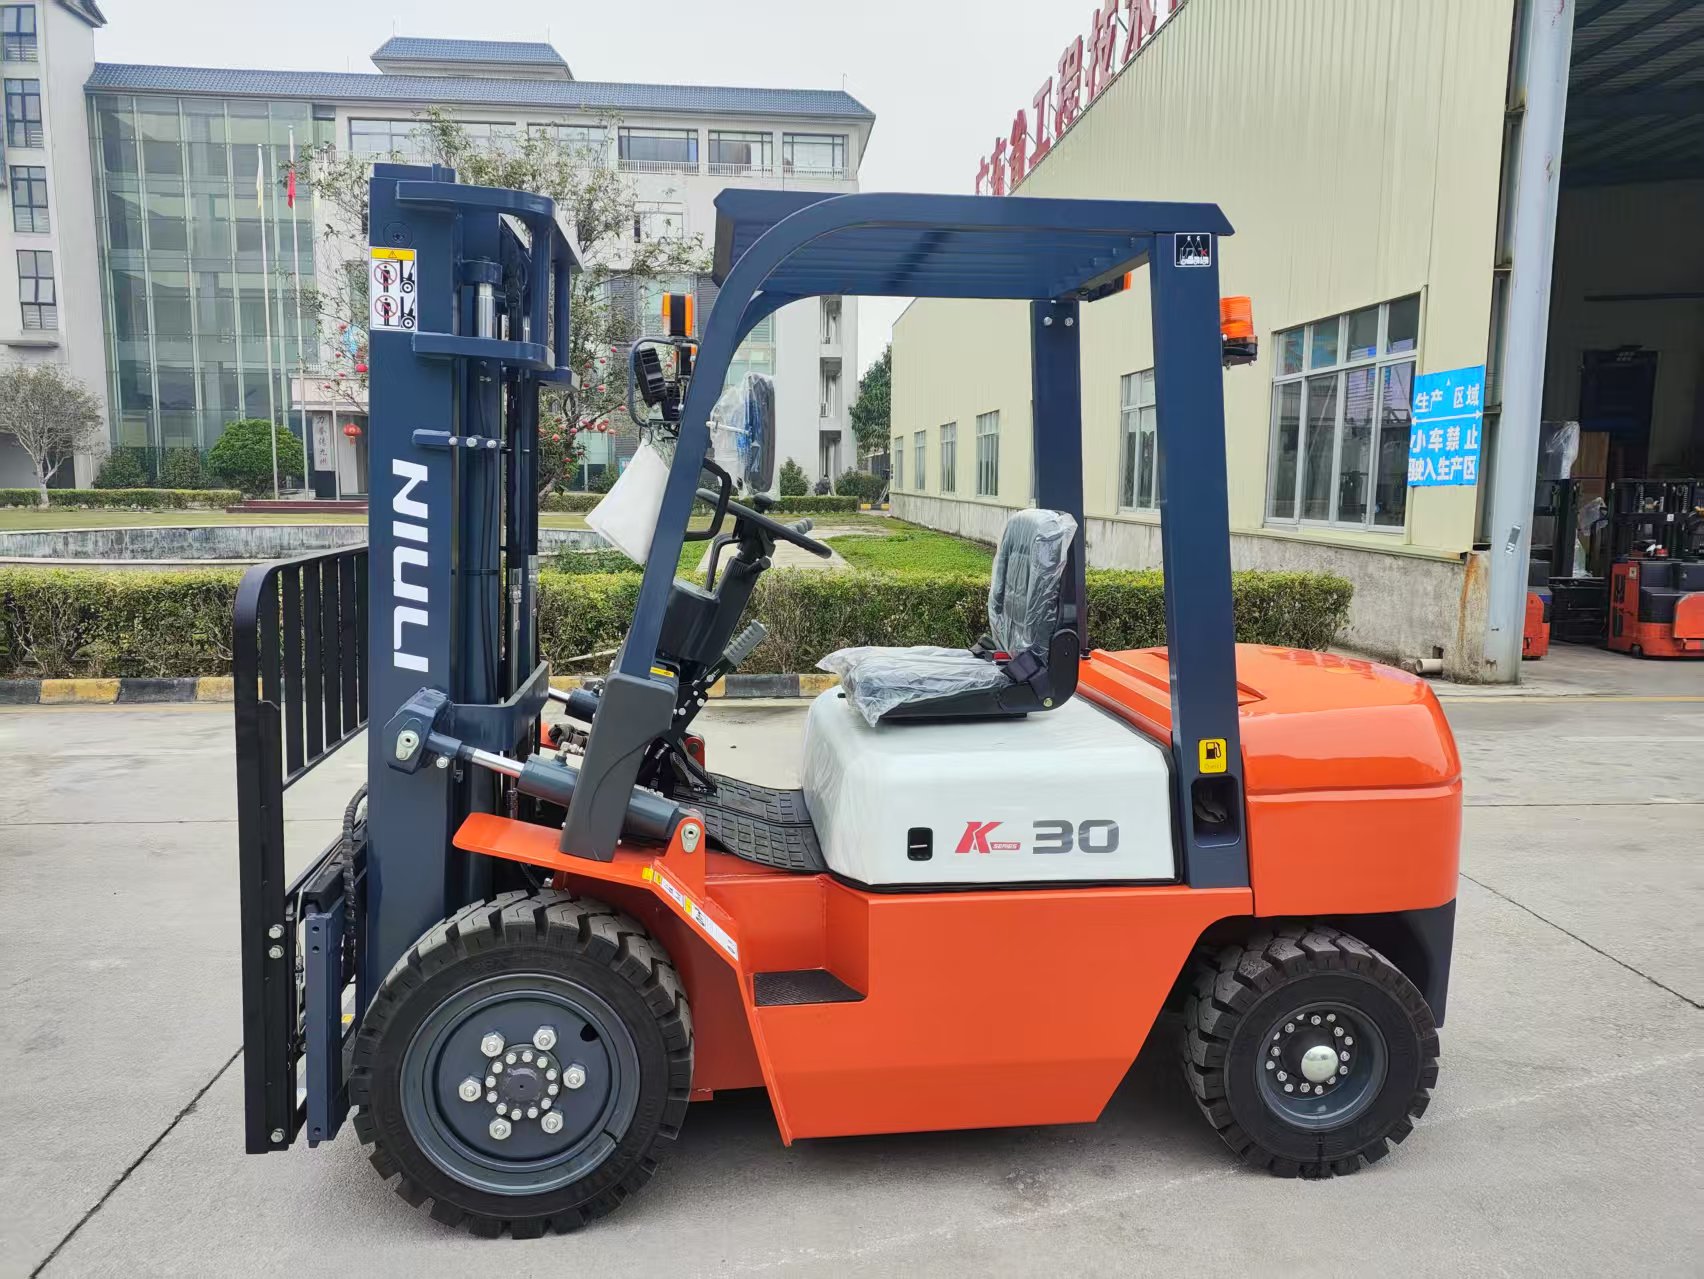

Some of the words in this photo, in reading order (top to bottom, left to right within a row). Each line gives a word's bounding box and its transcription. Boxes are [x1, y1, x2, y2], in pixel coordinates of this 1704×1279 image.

[1409, 424, 1478, 453] 小车禁止
[392, 458, 429, 673] NIULI
[955, 821, 1004, 853] K
[1033, 819, 1120, 854] 30
